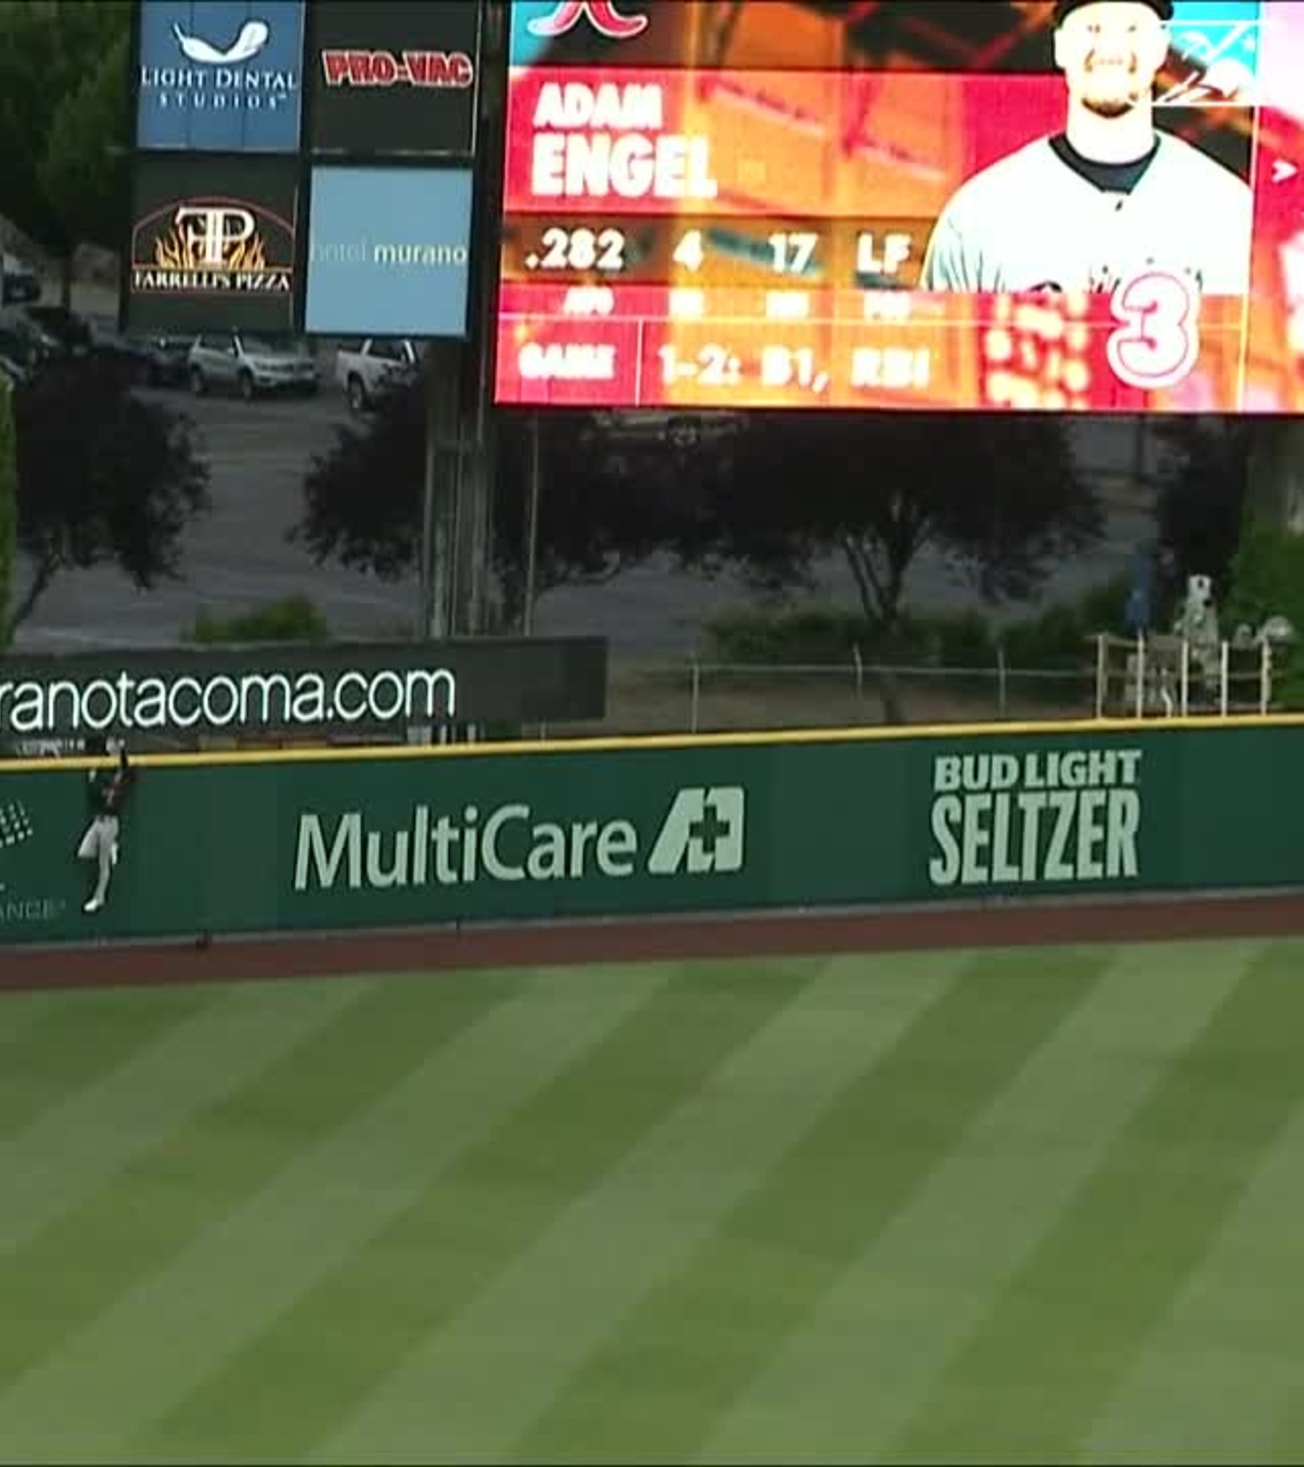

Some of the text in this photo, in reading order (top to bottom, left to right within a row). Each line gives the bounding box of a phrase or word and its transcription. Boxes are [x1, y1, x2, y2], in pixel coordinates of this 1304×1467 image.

[142, 66, 296, 90] LIGHT DENTAL
[322, 50, 474, 88] PRO-VAC
[533, 82, 663, 129] ADAM
[532, 132, 718, 199] ENGEL
[374, 243, 468, 265] murano
[525, 228, 910, 273] .282 4 17 LF
[236, 273, 290, 290] PIZZA
[1108, 270, 1200, 390] 3
[658, 344, 742, 386] 1-2:
[934, 749, 1142, 791] BUD LIGHT
[294, 804, 638, 890] MultiCare
[929, 788, 1141, 886] SELTZER
